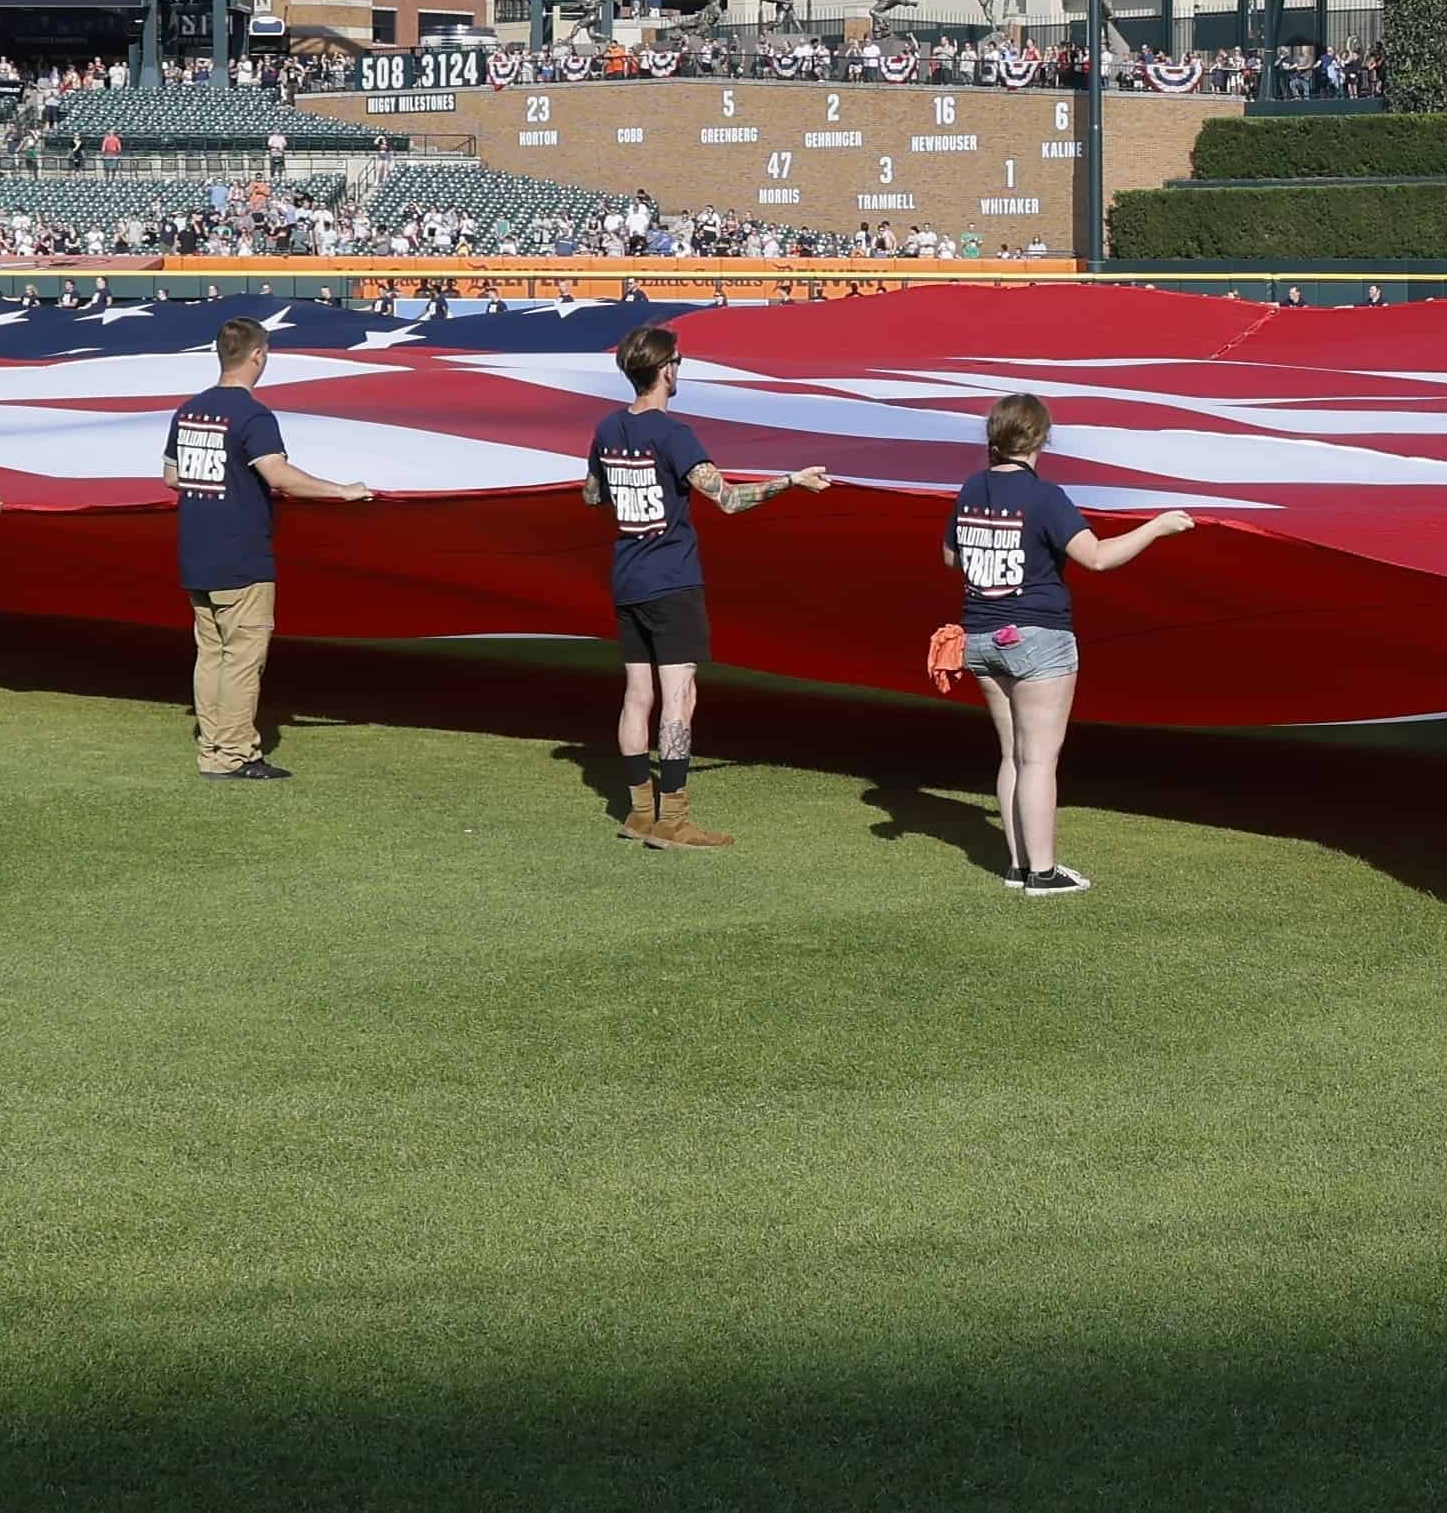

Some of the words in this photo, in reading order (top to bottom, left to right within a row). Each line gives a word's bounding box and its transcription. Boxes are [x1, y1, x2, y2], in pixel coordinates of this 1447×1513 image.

[362, 55, 404, 90] 508
[420, 50, 478, 87] 3124
[367, 97, 397, 113] MIGGY
[398, 94, 454, 112] MILESTONES
[526, 96, 550, 122] 23
[722, 90, 735, 117] 5
[826, 93, 841, 121] 2
[933, 97, 955, 125] 16
[1055, 102, 1069, 130] 6
[519, 130, 558, 146] HORTON
[617, 128, 644, 143] COBB
[700, 127, 758, 143] GREENBERG
[805, 131, 862, 148] GEHRINGER
[911, 135, 978, 151] NEWHOUSER
[1041, 142, 1083, 158] KALINE
[766, 151, 793, 179] 47
[879, 156, 893, 183] 3
[1004, 159, 1015, 187] 1
[759, 189, 800, 204] MORRIS
[857, 194, 915, 210] TRAMMELL
[980, 198, 1040, 214] WHITAKER
[610, 486, 665, 522] EROES
[994, 530, 1022, 549] OUR
[961, 548, 1025, 587] EROES
